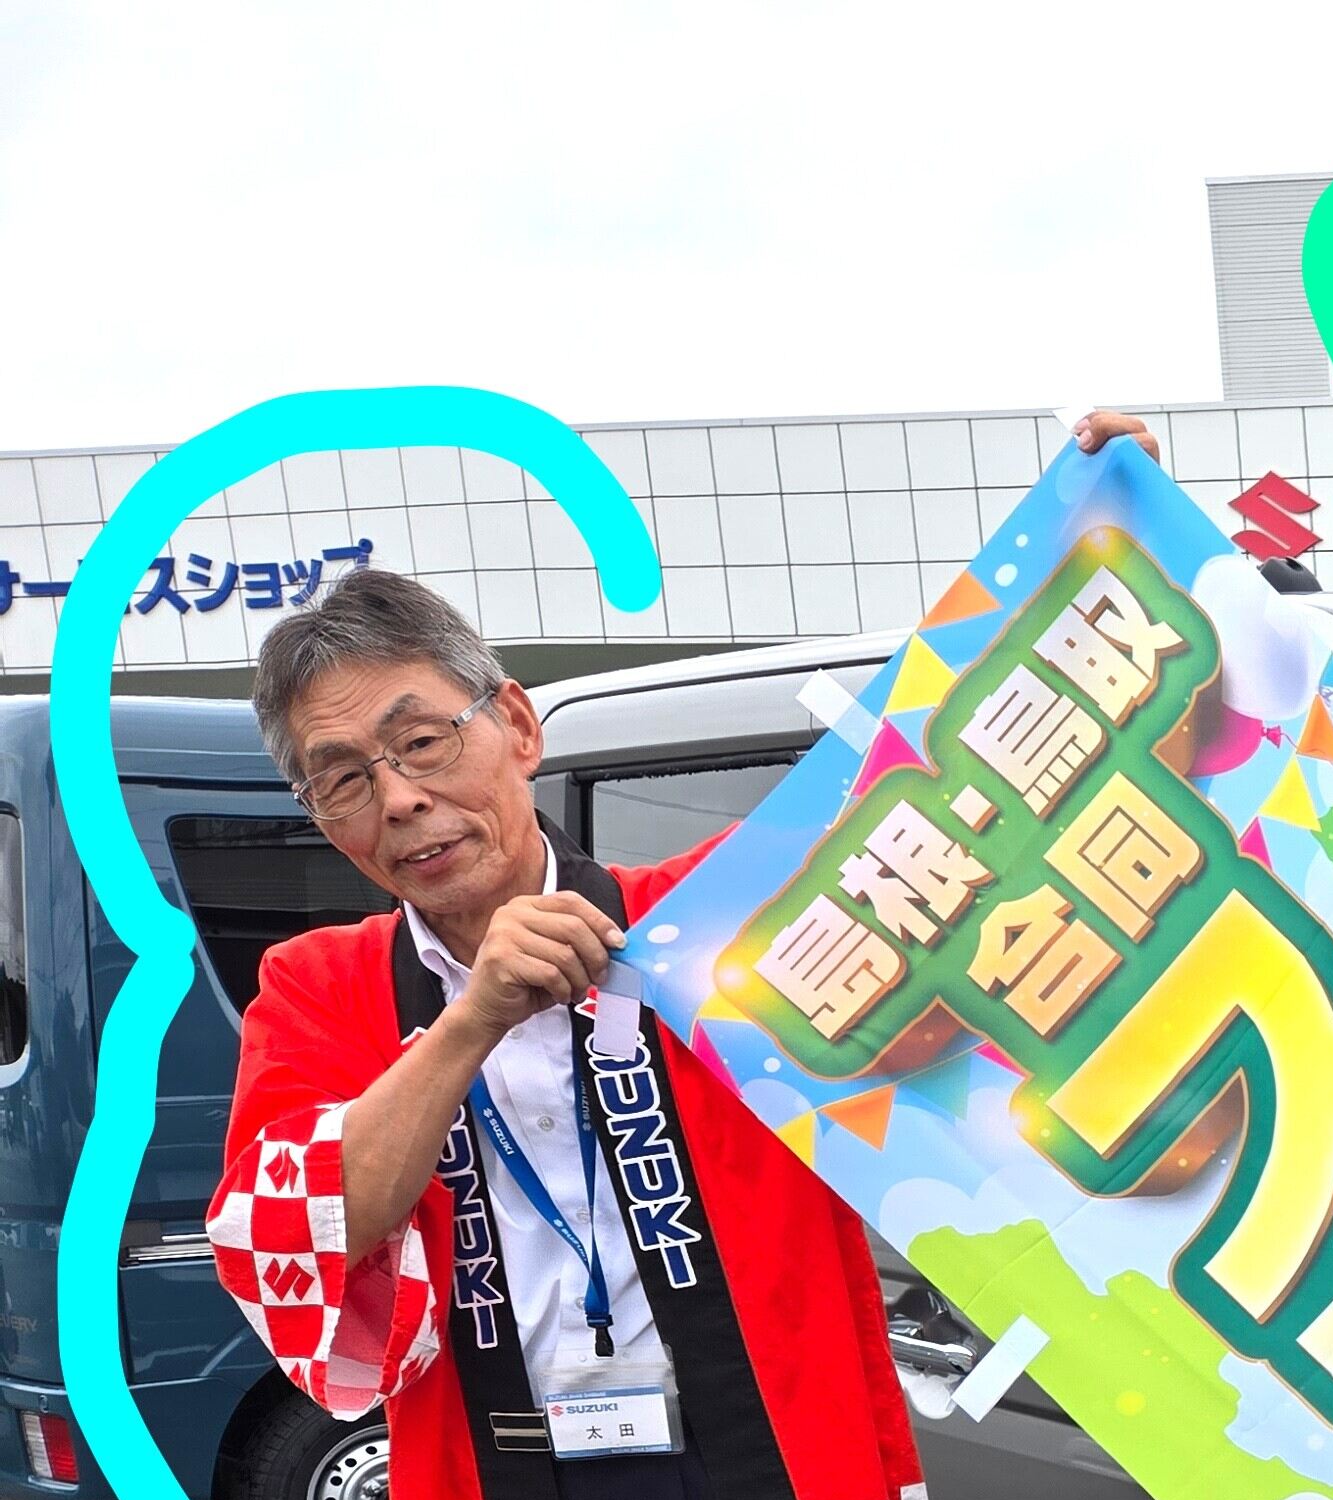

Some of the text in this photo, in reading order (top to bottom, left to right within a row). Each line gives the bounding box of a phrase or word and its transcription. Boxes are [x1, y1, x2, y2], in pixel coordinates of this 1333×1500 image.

[752, 565, 1186, 1041] 島根・鳥取
[966, 772, 1205, 1038] 合同
[436, 1105, 505, 1349] UZUKI
[489, 1118, 515, 1155] SUZUKI
[566, 1403, 619, 1415] SUZUKI
